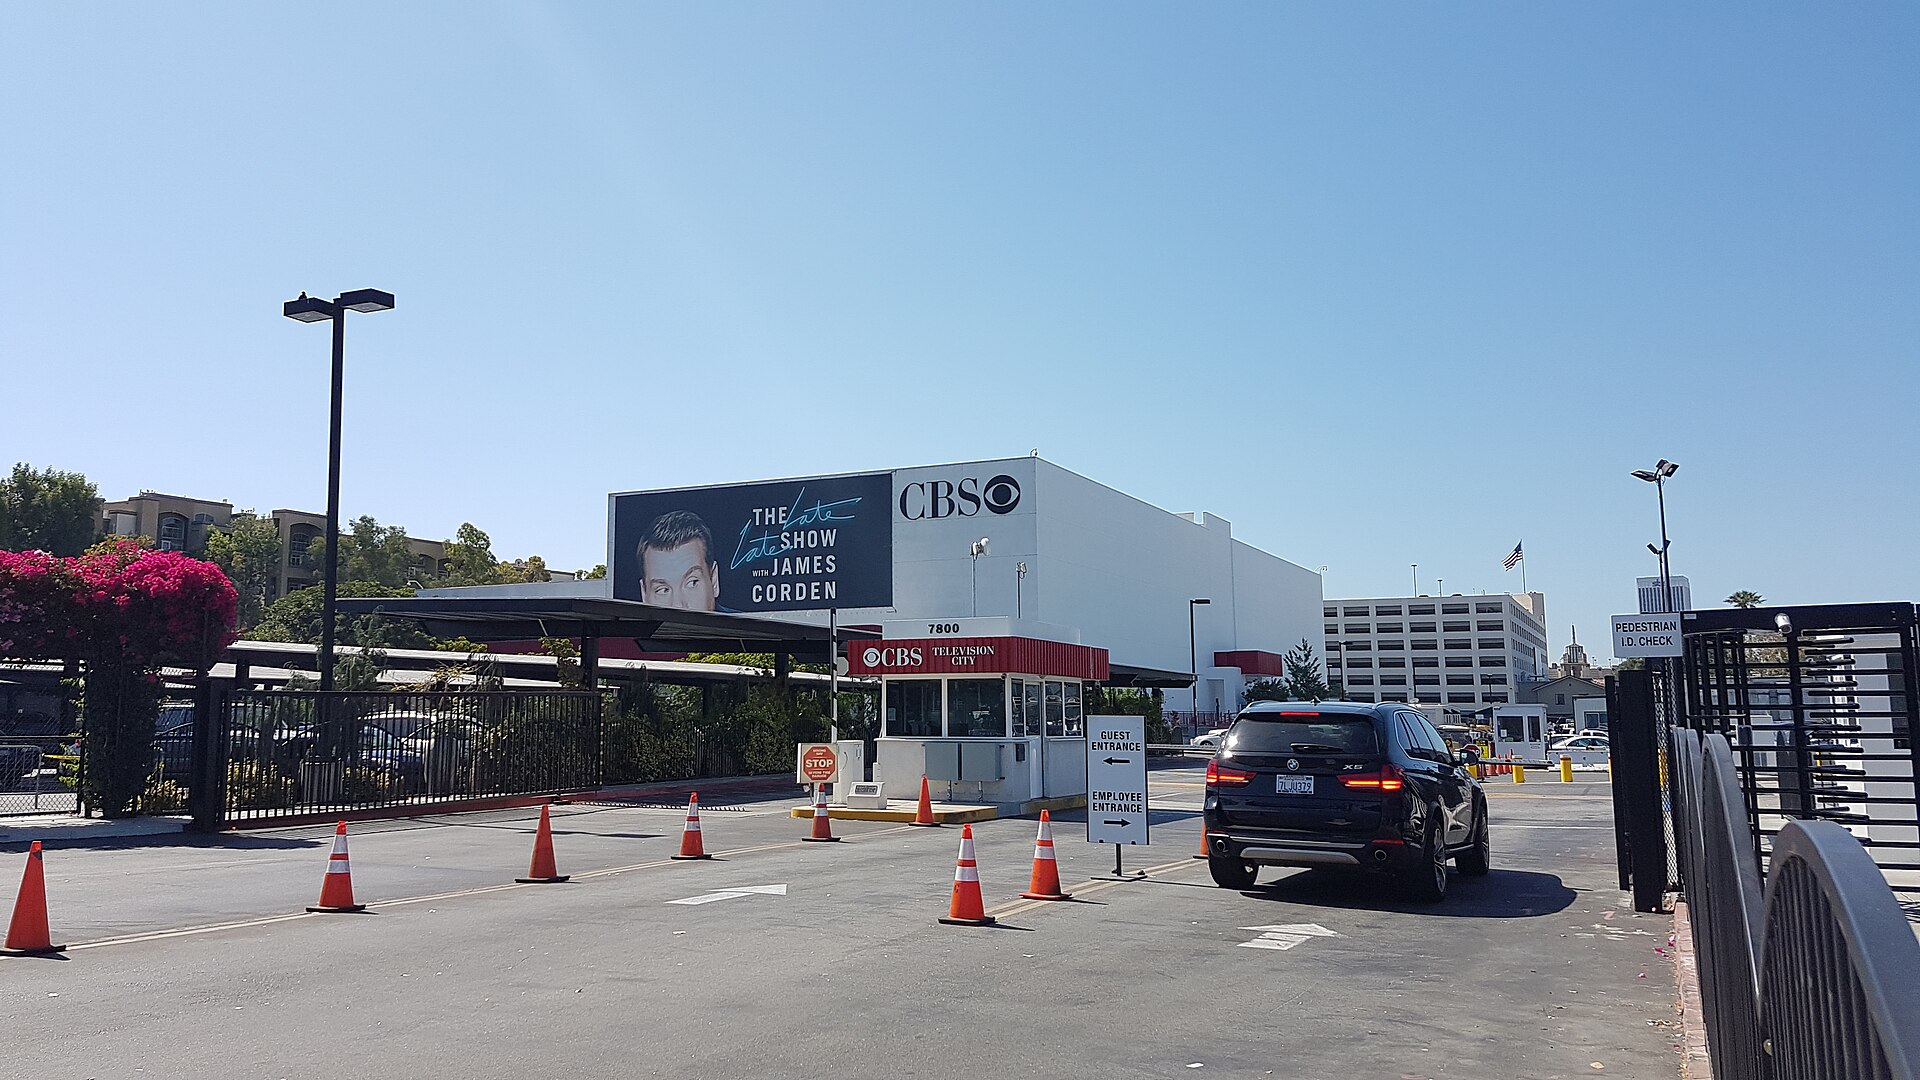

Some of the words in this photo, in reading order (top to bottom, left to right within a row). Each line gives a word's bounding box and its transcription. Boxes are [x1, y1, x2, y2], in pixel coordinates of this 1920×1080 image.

[900, 478, 981, 520] CBS
[752, 506, 788, 526] THE
[782, 486, 863, 531] Late
[730, 518, 793, 570] Late
[780, 528, 837, 550] SHOW
[752, 569, 769, 577] WITH
[771, 554, 836, 577] JAMES
[752, 581, 836, 602] CORDEN
[928, 623, 959, 634] 7800
[1616, 621, 1676, 632] PEDESTRIAN
[1622, 637, 1636, 646] I.D.
[1639, 636, 1673, 646] CHECK
[882, 647, 922, 666] CBS
[932, 646, 994, 656] TELEVISION
[952, 656, 975, 665] CITY
[1101, 731, 1130, 739] GUEST
[1092, 742, 1140, 751] ENTRANCE
[805, 758, 834, 768] STOP
[1279, 781, 1312, 791] 7LJU379
[1093, 792, 1142, 801] EMPLOYEE
[1093, 803, 1142, 812] ENTRANCE
